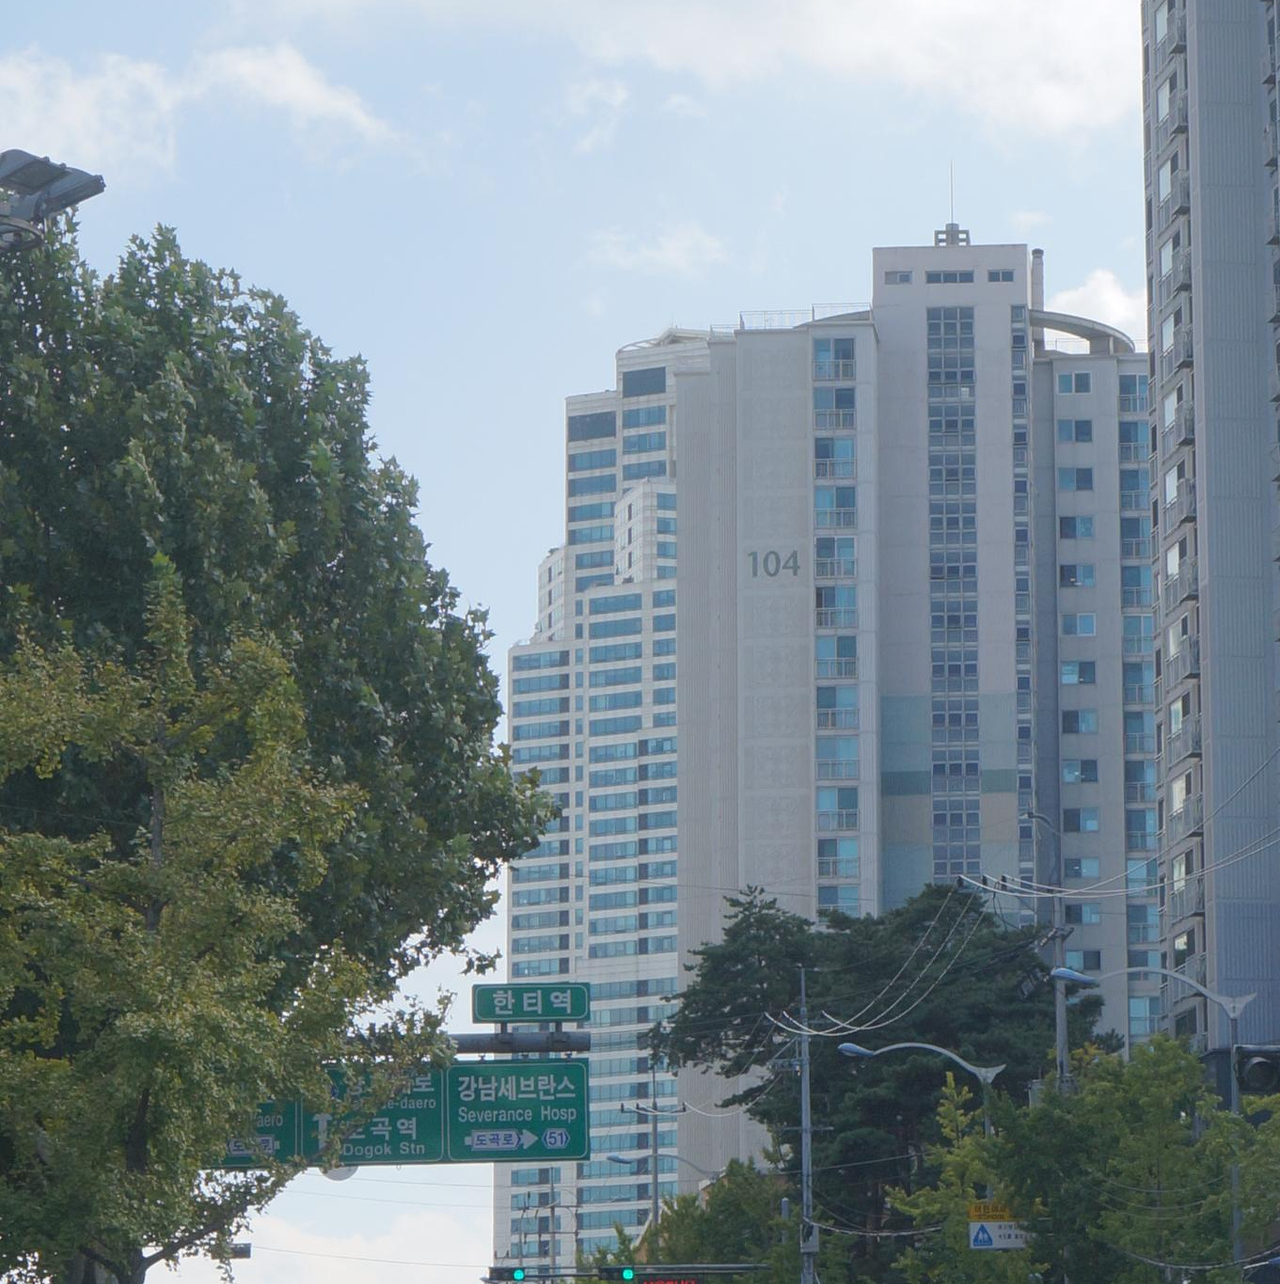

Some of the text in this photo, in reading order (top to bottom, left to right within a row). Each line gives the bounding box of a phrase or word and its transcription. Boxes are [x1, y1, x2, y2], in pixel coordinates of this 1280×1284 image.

[747, 550, 801, 578] 104
[492, 988, 573, 1015] 한티역
[458, 1074, 577, 1102] 강남세브란스
[458, 1105, 577, 1124] Severance Hosp
[474, 1131, 517, 1149] 도곡로
[546, 1131, 566, 1147] 51
[342, 1142, 425, 1159] Dogok Stn
